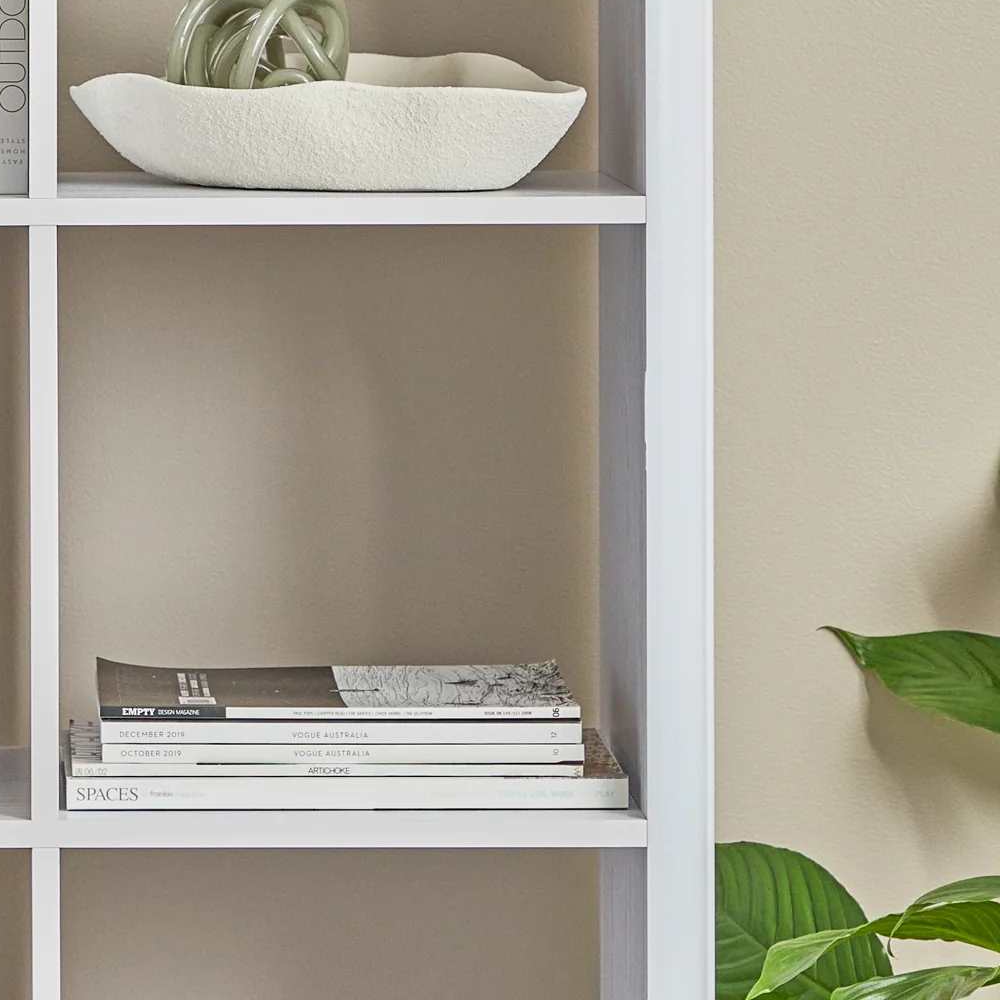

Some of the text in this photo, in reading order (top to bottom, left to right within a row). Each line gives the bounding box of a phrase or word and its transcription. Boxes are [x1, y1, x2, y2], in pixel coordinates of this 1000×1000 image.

[122, 708, 155, 716] EMPTY
[552, 707, 560, 718] 06
[308, 767, 350, 775] ARTICHOKE
[76, 787, 139, 802] SPACES
[149, 790, 174, 798] frankie
